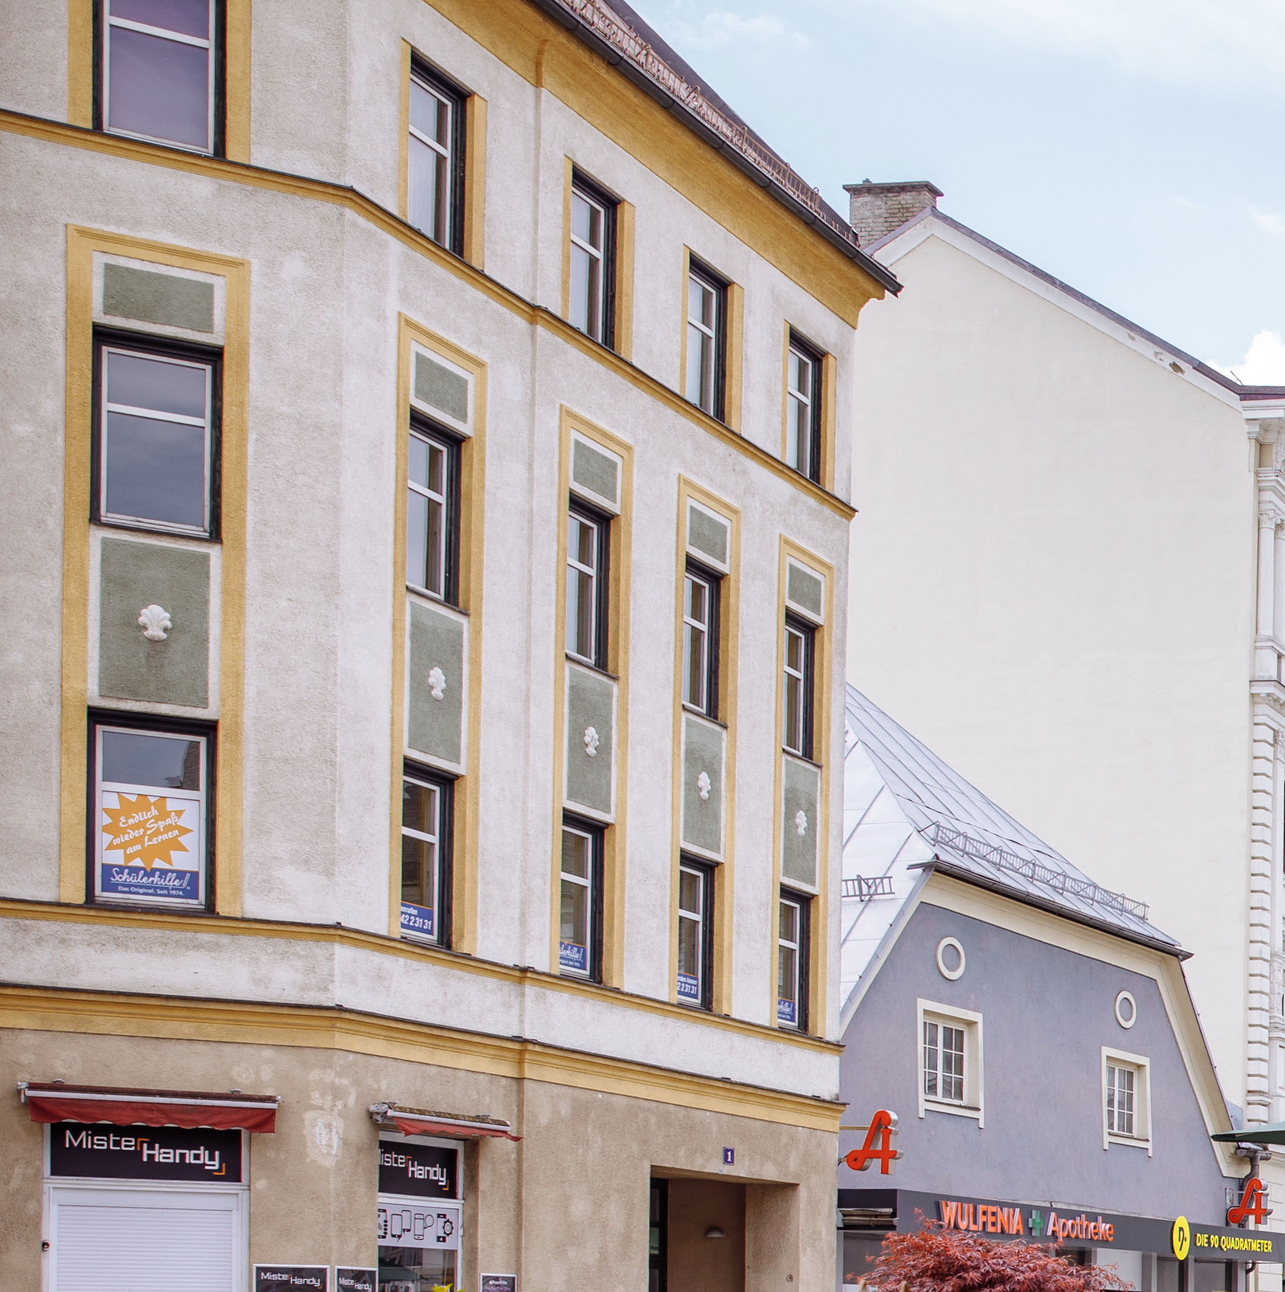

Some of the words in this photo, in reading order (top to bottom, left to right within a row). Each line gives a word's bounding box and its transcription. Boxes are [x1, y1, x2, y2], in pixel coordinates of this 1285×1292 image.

[112, 828, 145, 846] wieder
[145, 811, 179, 835] Spaß
[119, 805, 159, 828] Endlich
[126, 843, 142, 855] am
[144, 828, 179, 848] Lernen
[423, 919, 432, 930] 31
[142, 1143, 220, 1170] Handy
[408, 1160, 447, 1186] Handy
[942, 1200, 1025, 1236] WULFENIA
[1047, 1211, 1115, 1243] Apotheke
[1195, 1232, 1209, 1248] DIE
[1210, 1234, 1219, 1249] 90
[1220, 1235, 1273, 1254] QUADRATMETER
[290, 1276, 321, 1287] Handy
